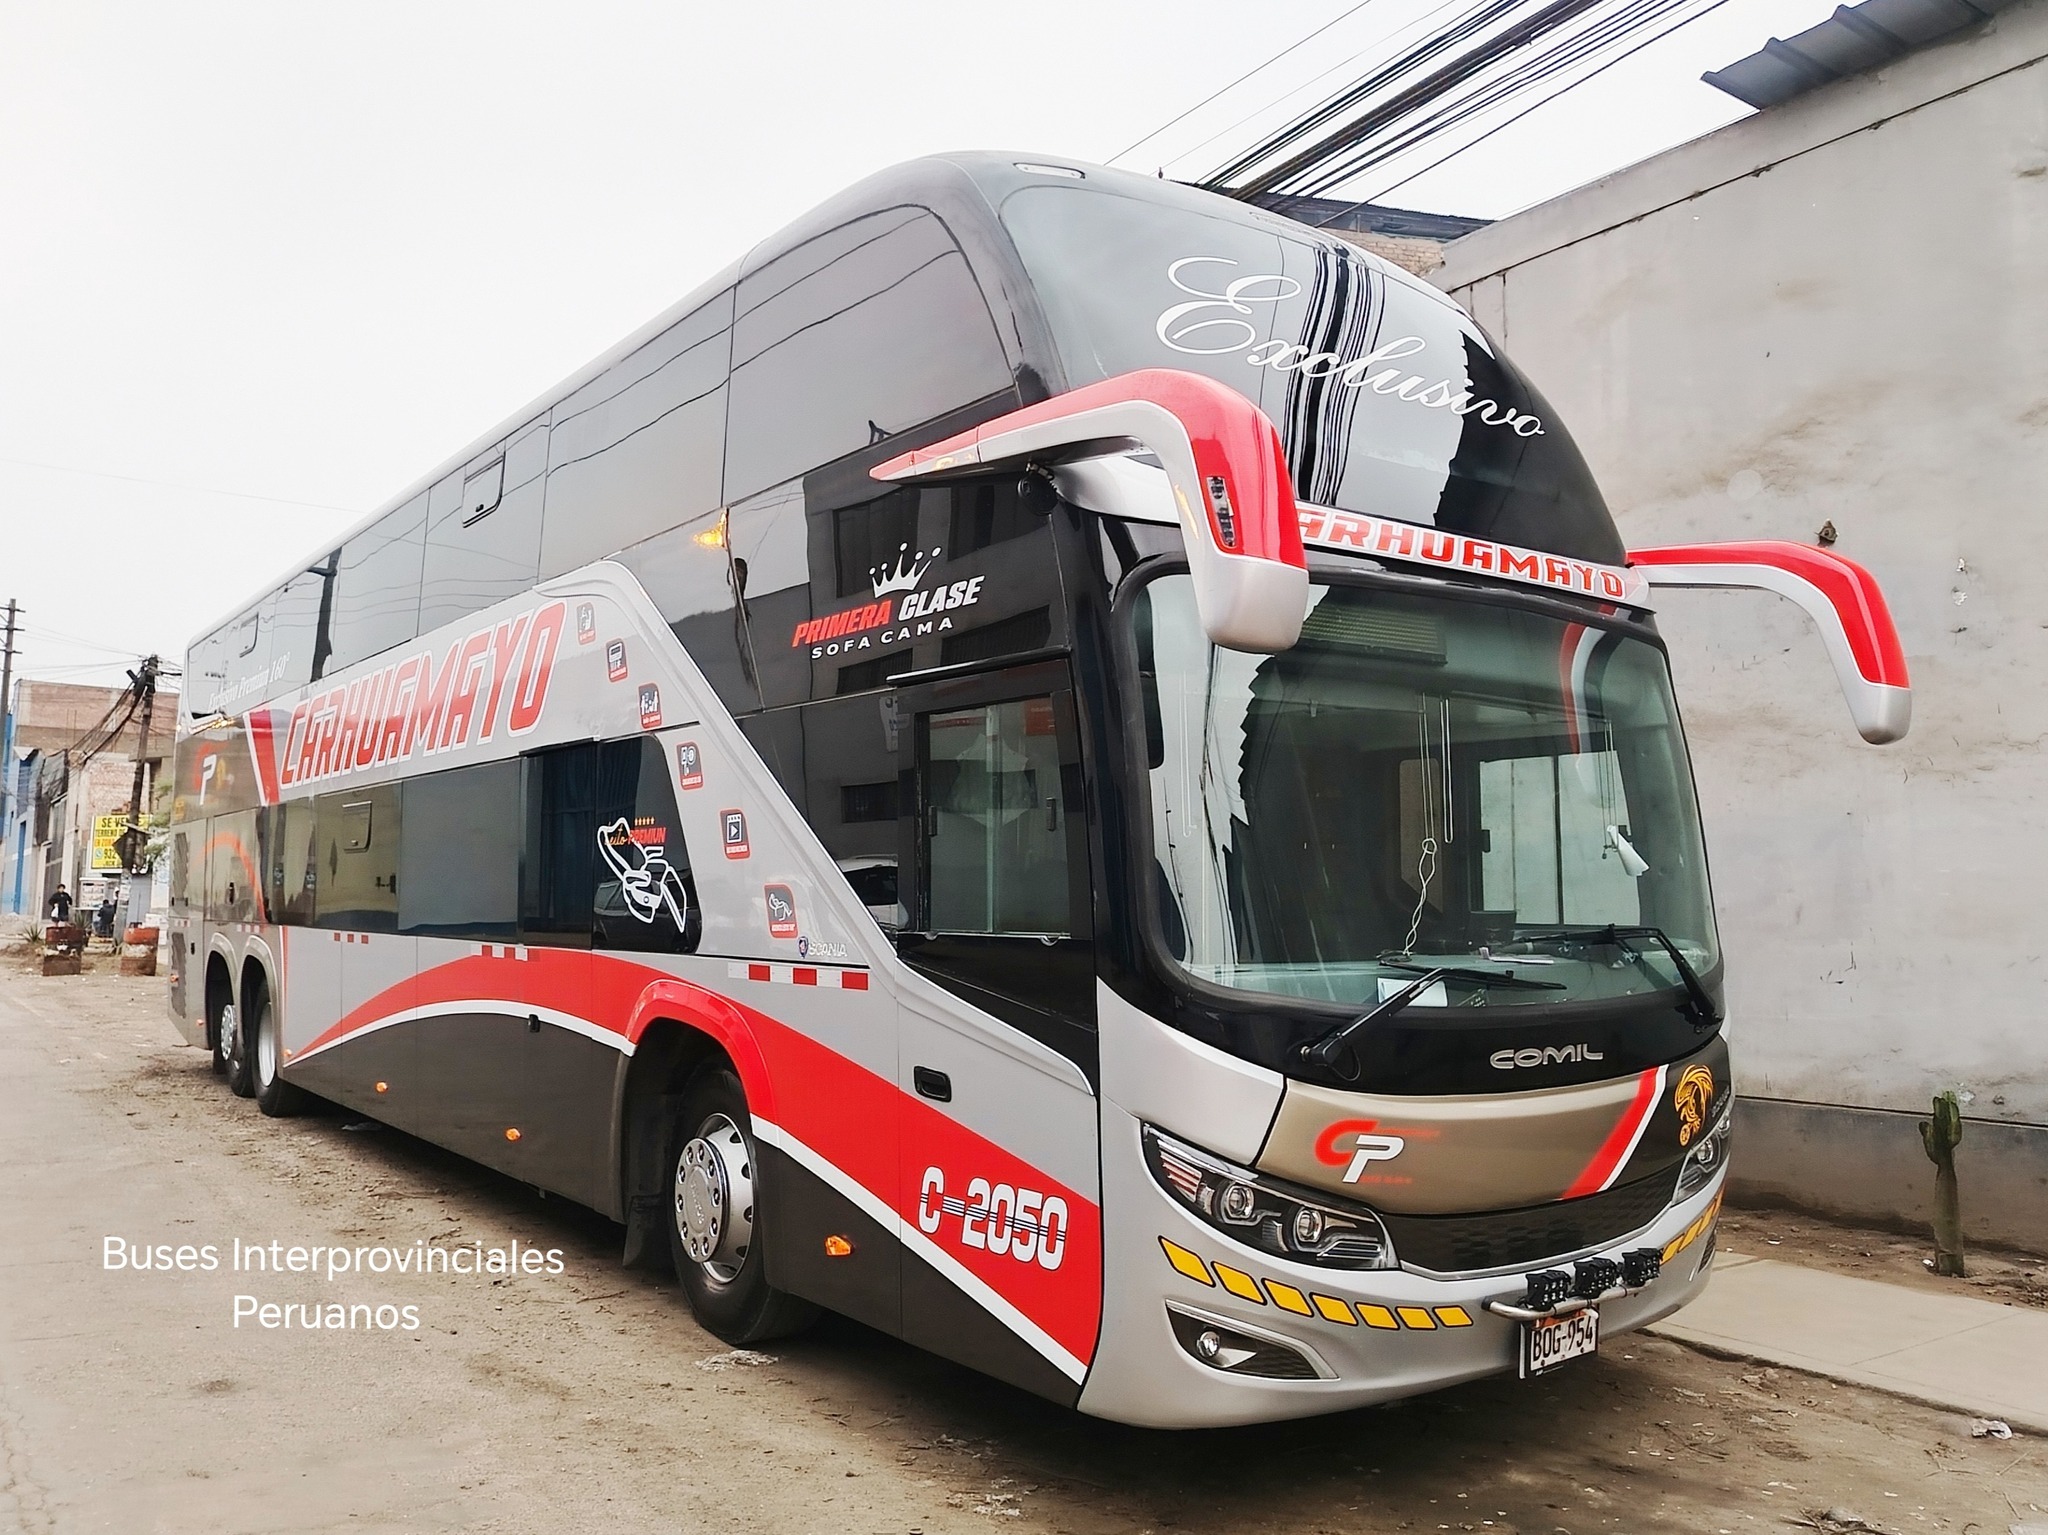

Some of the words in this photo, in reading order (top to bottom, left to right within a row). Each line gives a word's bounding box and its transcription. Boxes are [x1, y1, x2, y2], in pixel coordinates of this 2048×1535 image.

[1155, 255, 1546, 438] Exclusivo
[1298, 507, 1626, 601] ARHUAMAYO
[792, 600, 892, 648] PRIMERA
[898, 575, 986, 621] CLASE
[811, 636, 871, 659] SOFA
[880, 617, 953, 644] CAMA
[280, 599, 567, 789] CARHUAMAYO
[101, 817, 112, 828] SE
[808, 942, 848, 957] SCANIA
[1489, 1043, 1604, 1069] COMIL
[918, 1166, 1068, 1270] C-2050
